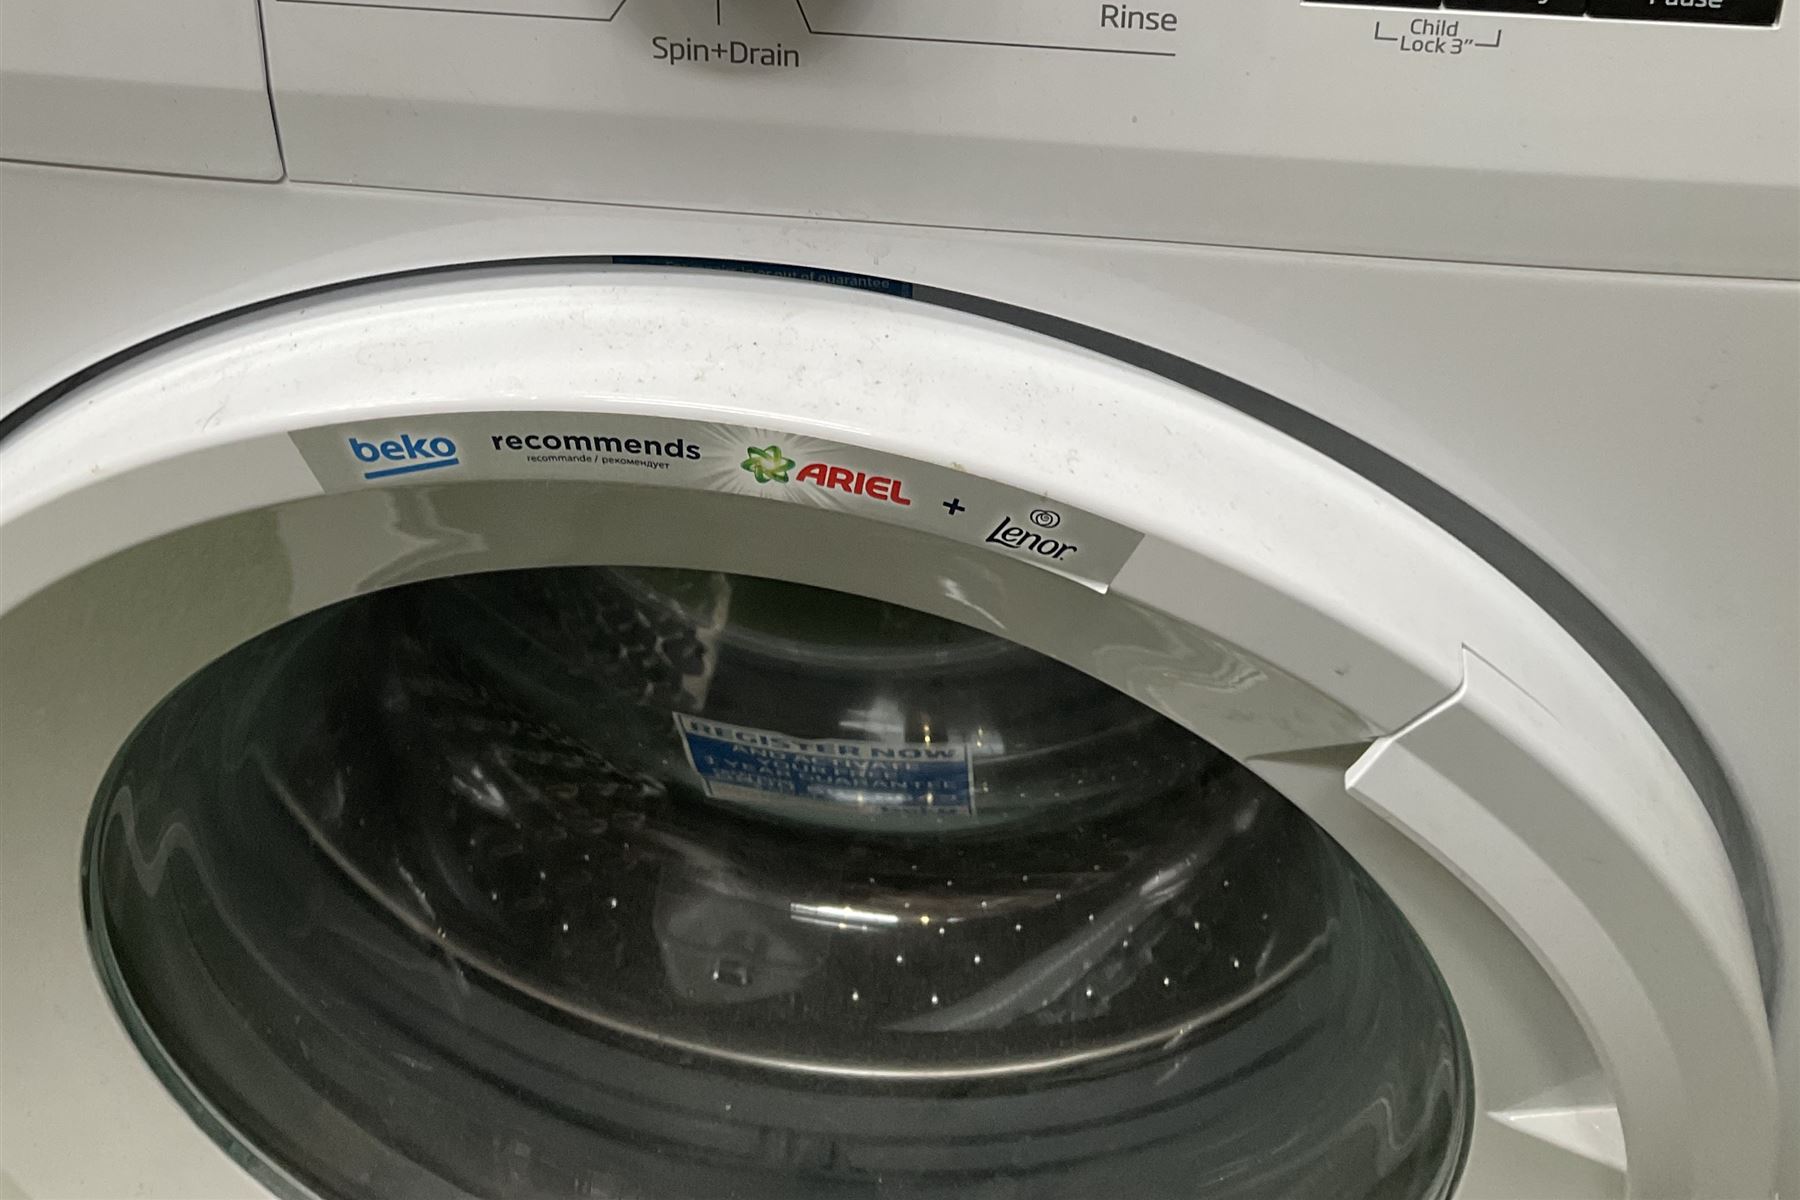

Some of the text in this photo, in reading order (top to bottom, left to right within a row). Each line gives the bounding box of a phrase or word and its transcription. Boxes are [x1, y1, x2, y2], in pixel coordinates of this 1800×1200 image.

[1100, 3, 1178, 32] Rinse
[1410, 18, 1460, 37] Child
[652, 36, 800, 68] Spin+Drain
[1399, 35, 1447, 54] Lock
[348, 433, 457, 463] beko
[490, 432, 702, 461] recommends
[526, 453, 593, 465] recommande
[601, 456, 670, 470] рекомендует
[795, 463, 911, 506] ARIEL
